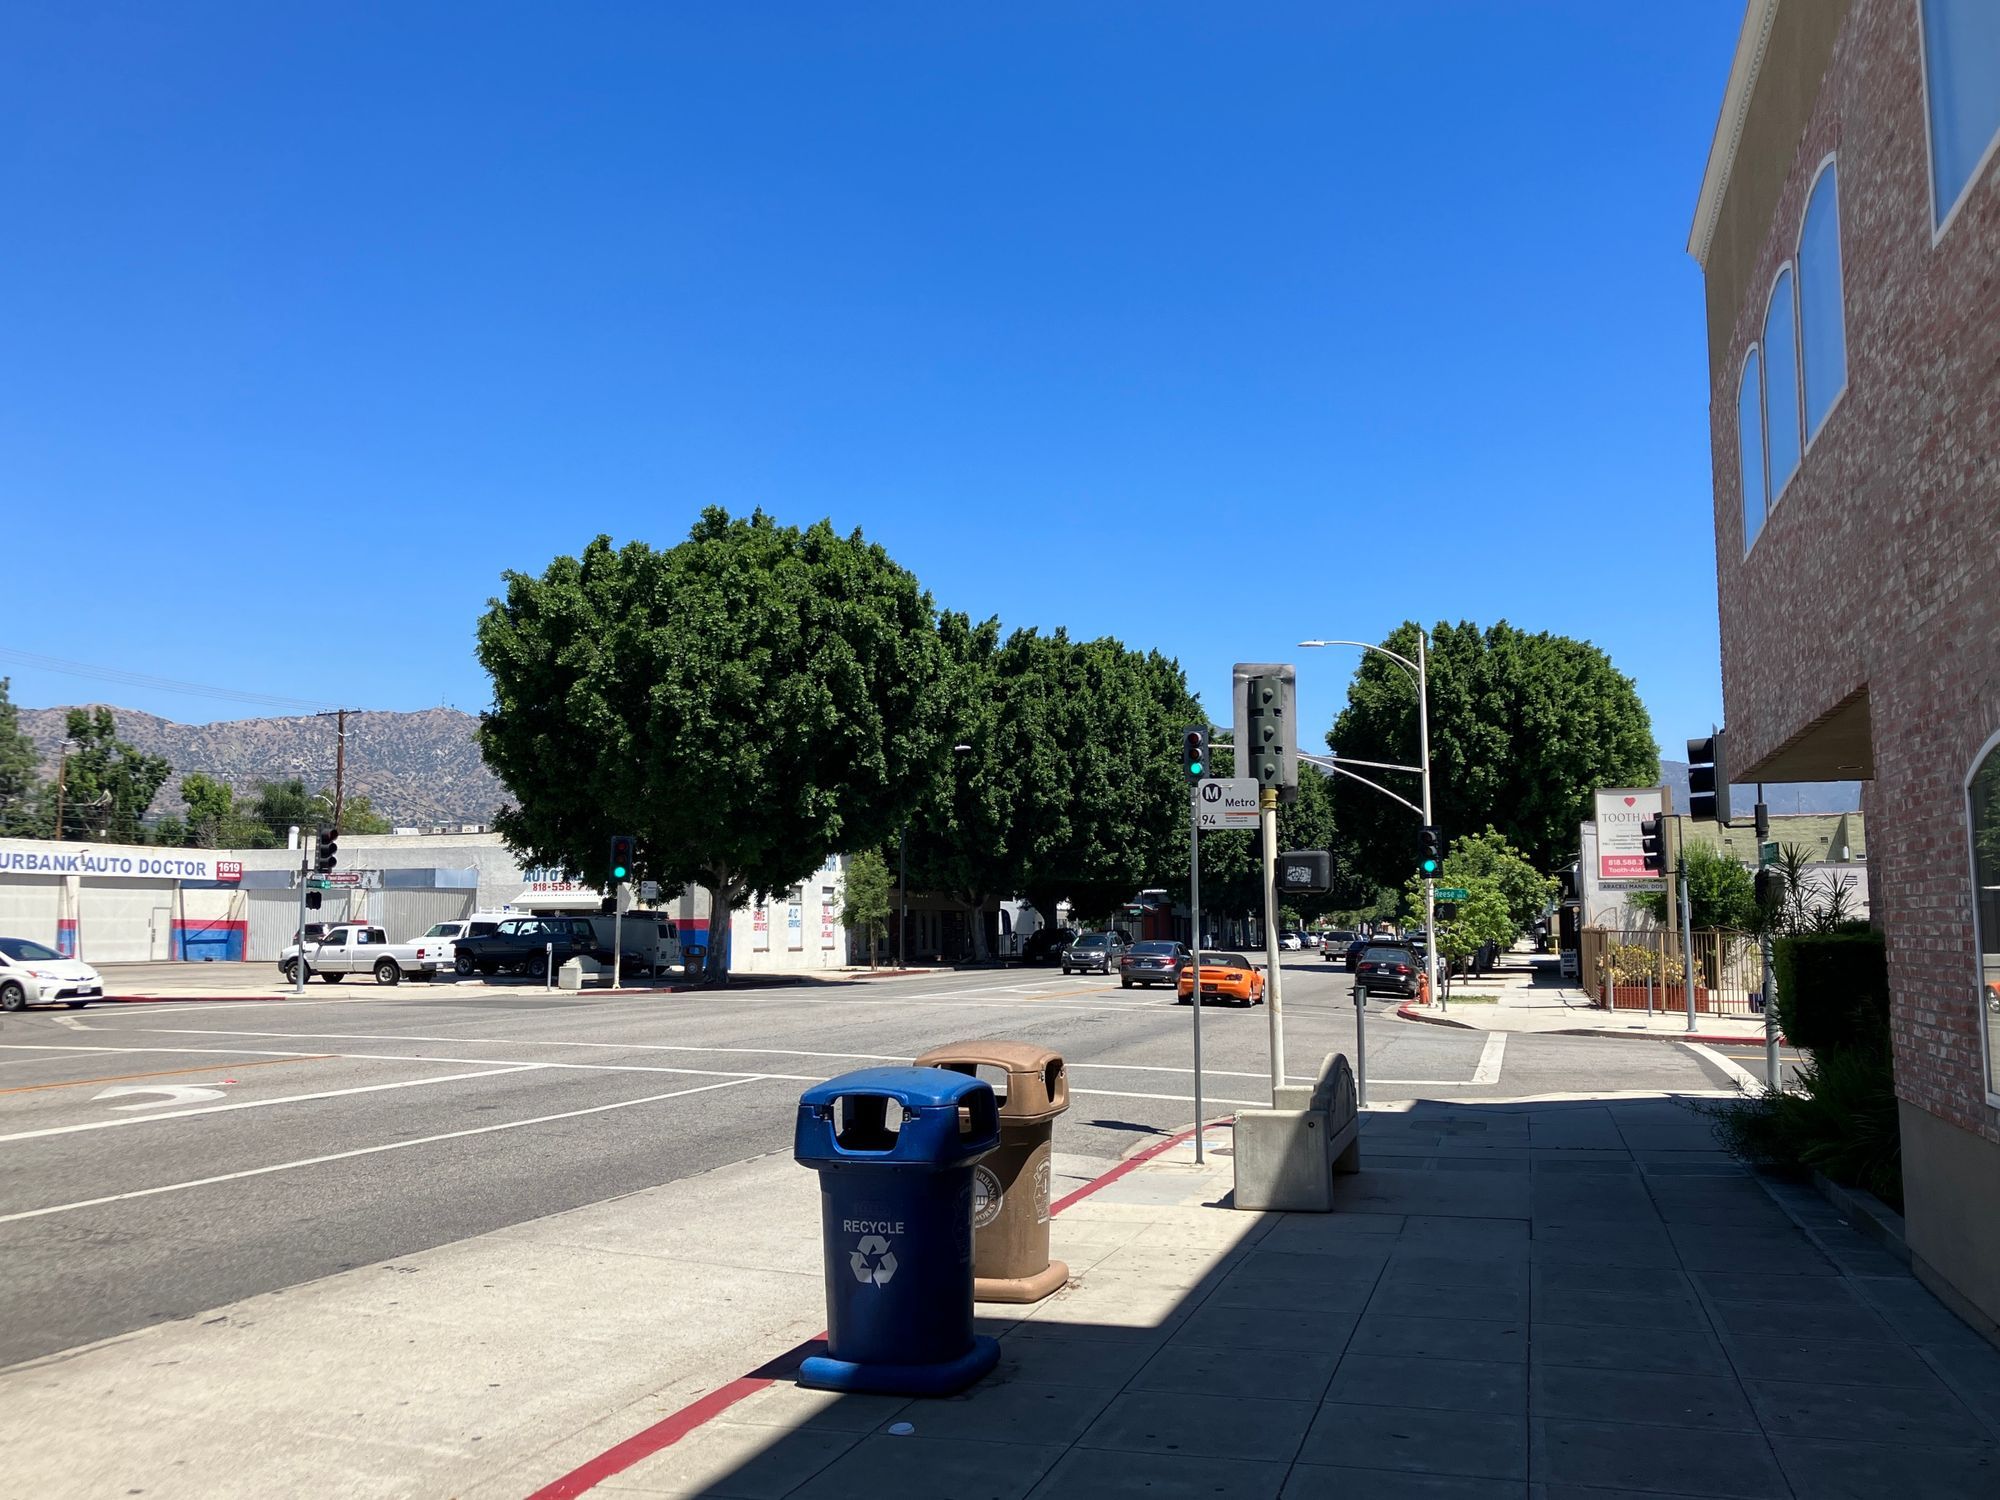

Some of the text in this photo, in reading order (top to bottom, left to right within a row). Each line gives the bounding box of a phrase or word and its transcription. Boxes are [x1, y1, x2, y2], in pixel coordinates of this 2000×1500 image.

[1204, 786, 1219, 800] M
[1225, 798, 1256, 807] Metro
[1201, 814, 1216, 825] 94
[1601, 812, 1656, 823] TOOTHAI
[0, 853, 206, 877] URBANK AUTO DOCTOR
[218, 862, 240, 873] 1619
[523, 869, 558, 883] AUTO
[1434, 888, 1455, 898] Reese
[843, 1220, 905, 1235] RECYCLE
